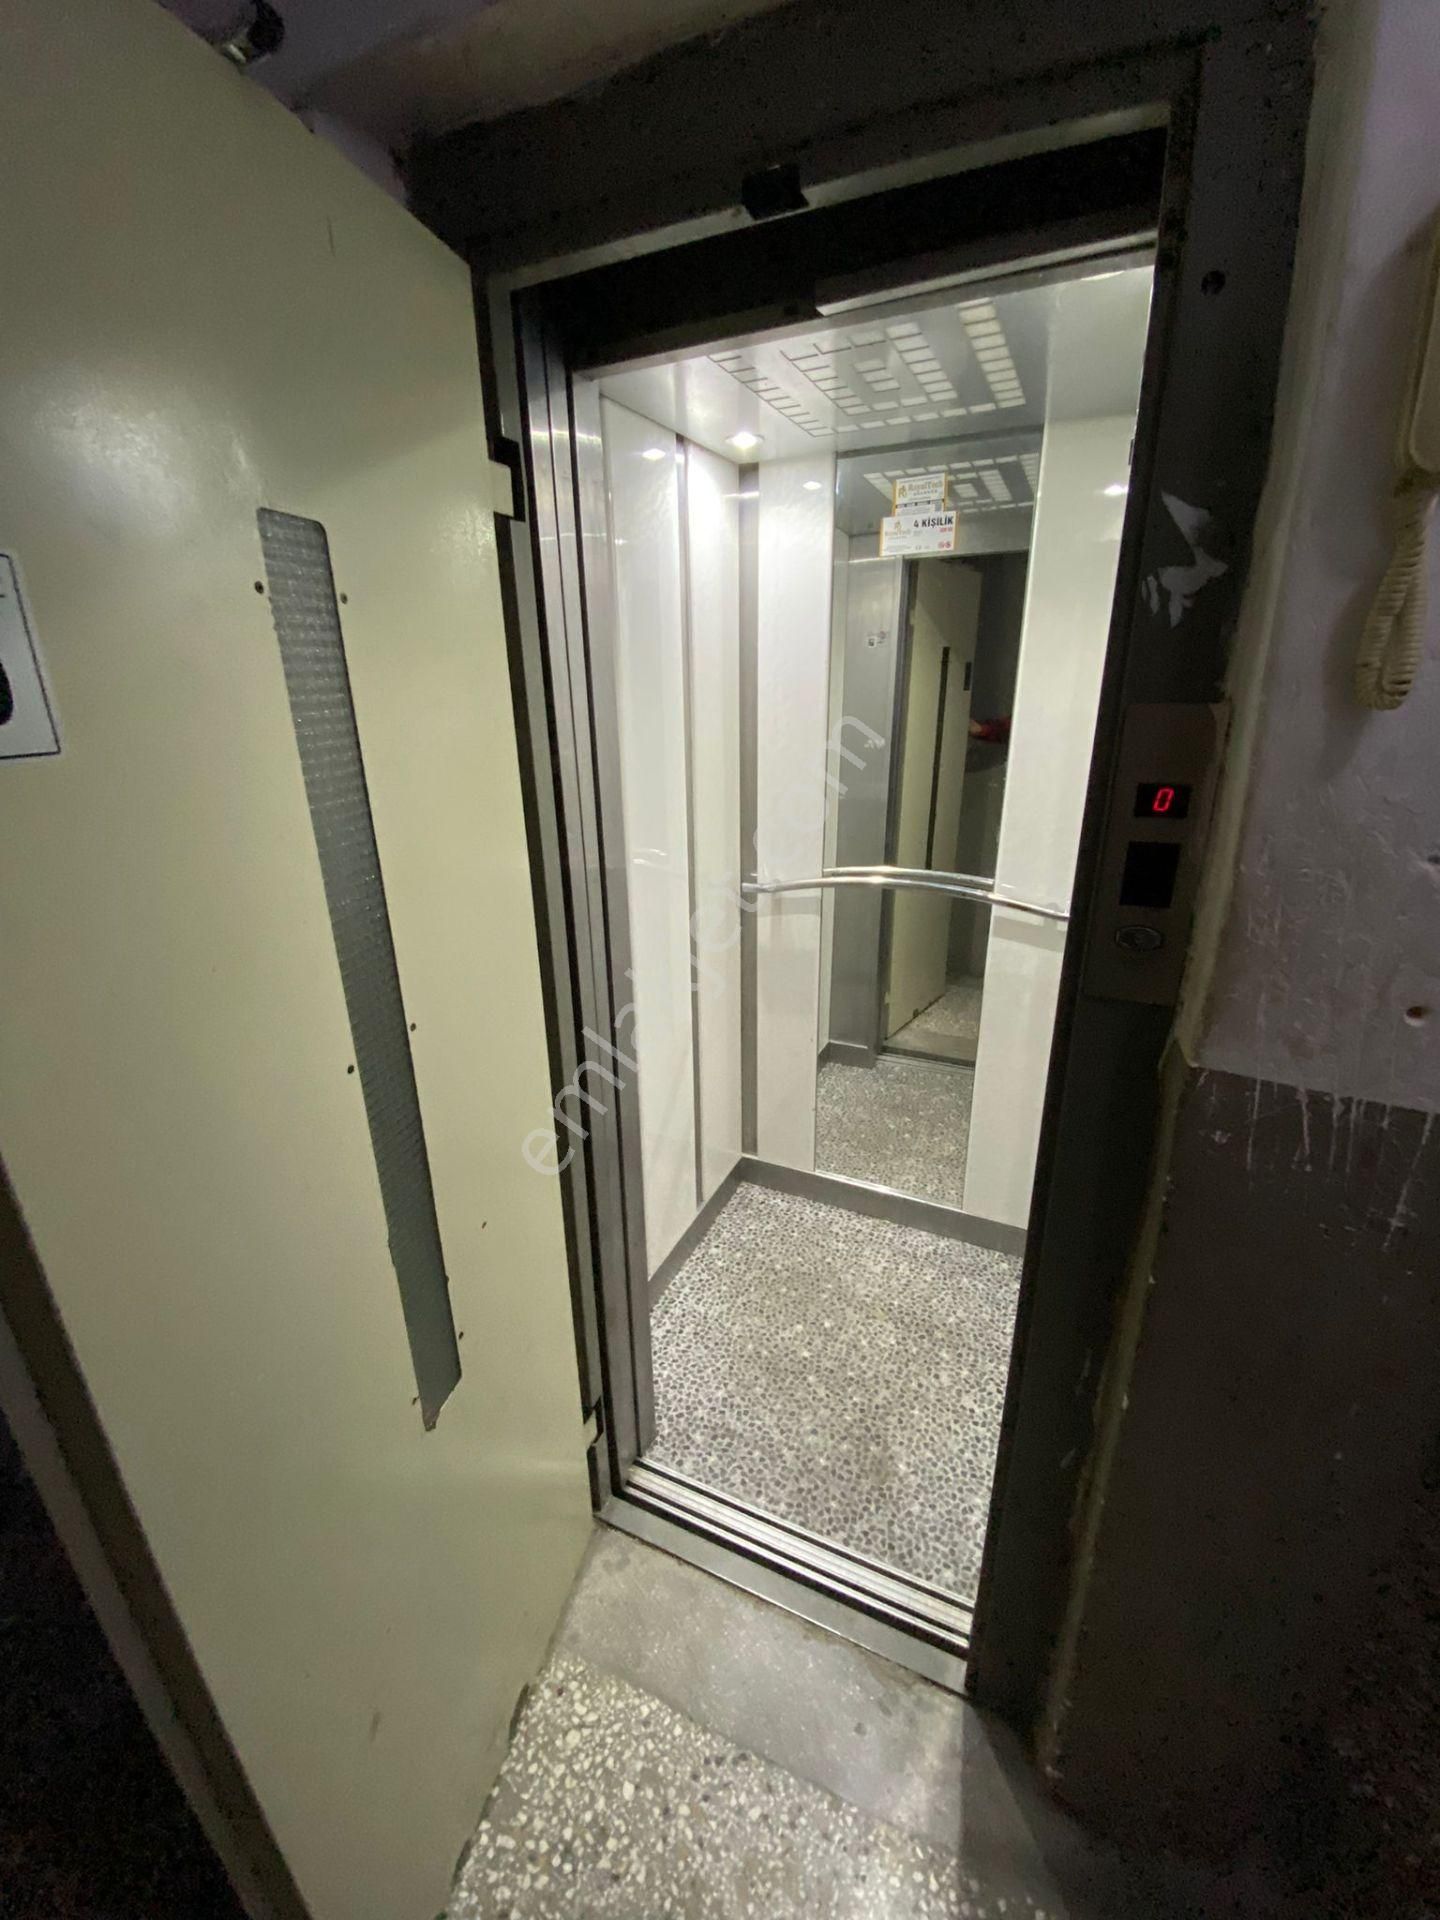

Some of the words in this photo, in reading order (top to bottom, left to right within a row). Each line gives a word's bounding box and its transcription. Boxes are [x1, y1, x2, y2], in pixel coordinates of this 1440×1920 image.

[913, 519, 919, 528] 4
[921, 515, 954, 529] KİŞİLİK
[1152, 787, 1175, 812] 0
